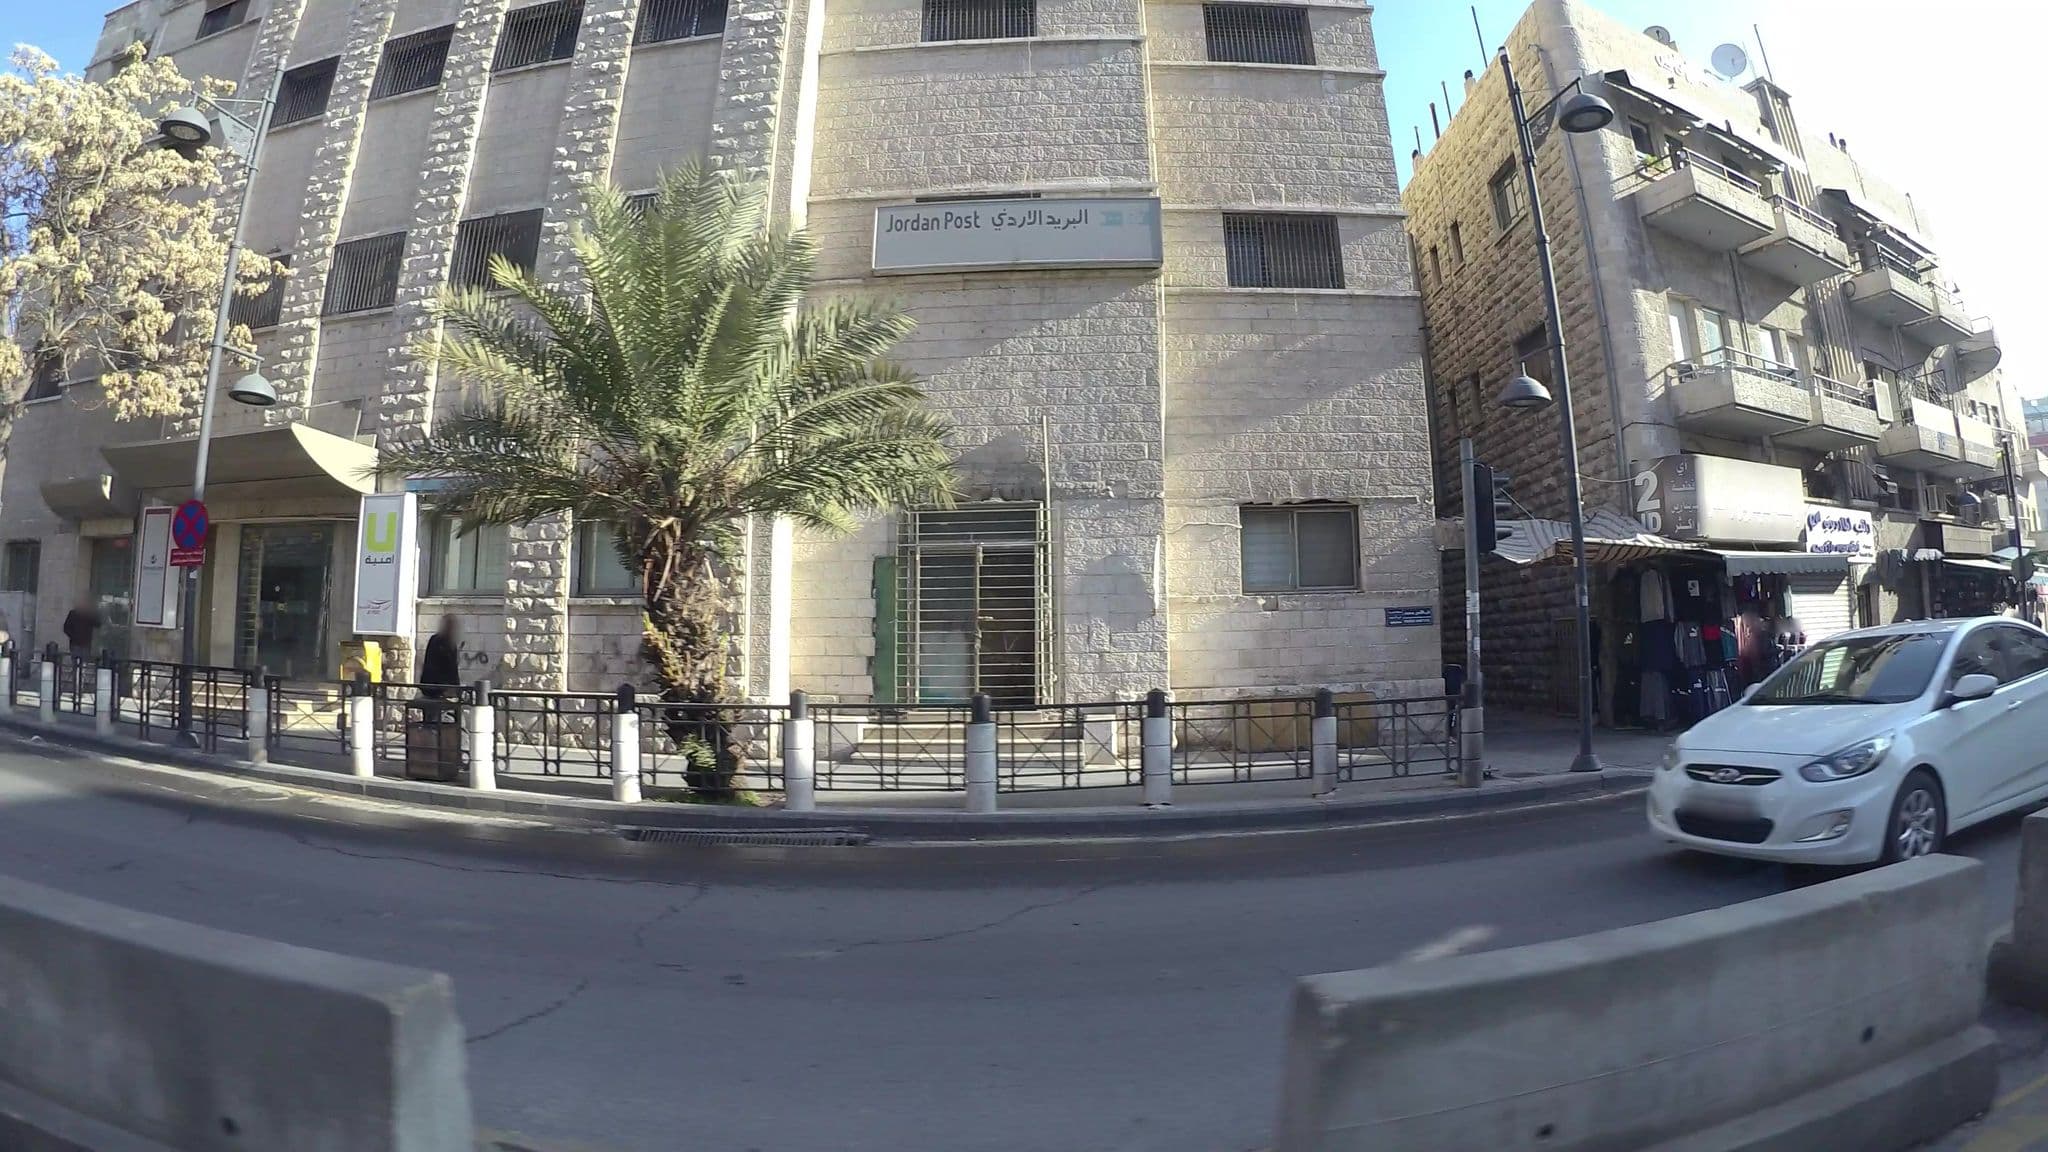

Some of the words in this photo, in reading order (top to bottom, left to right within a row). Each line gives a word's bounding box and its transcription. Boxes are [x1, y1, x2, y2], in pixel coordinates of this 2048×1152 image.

[886, 212, 940, 232] Jordan
[944, 211, 980, 230] Post
[1046, 208, 1088, 230] البريد
[1634, 470, 1660, 513] 2
